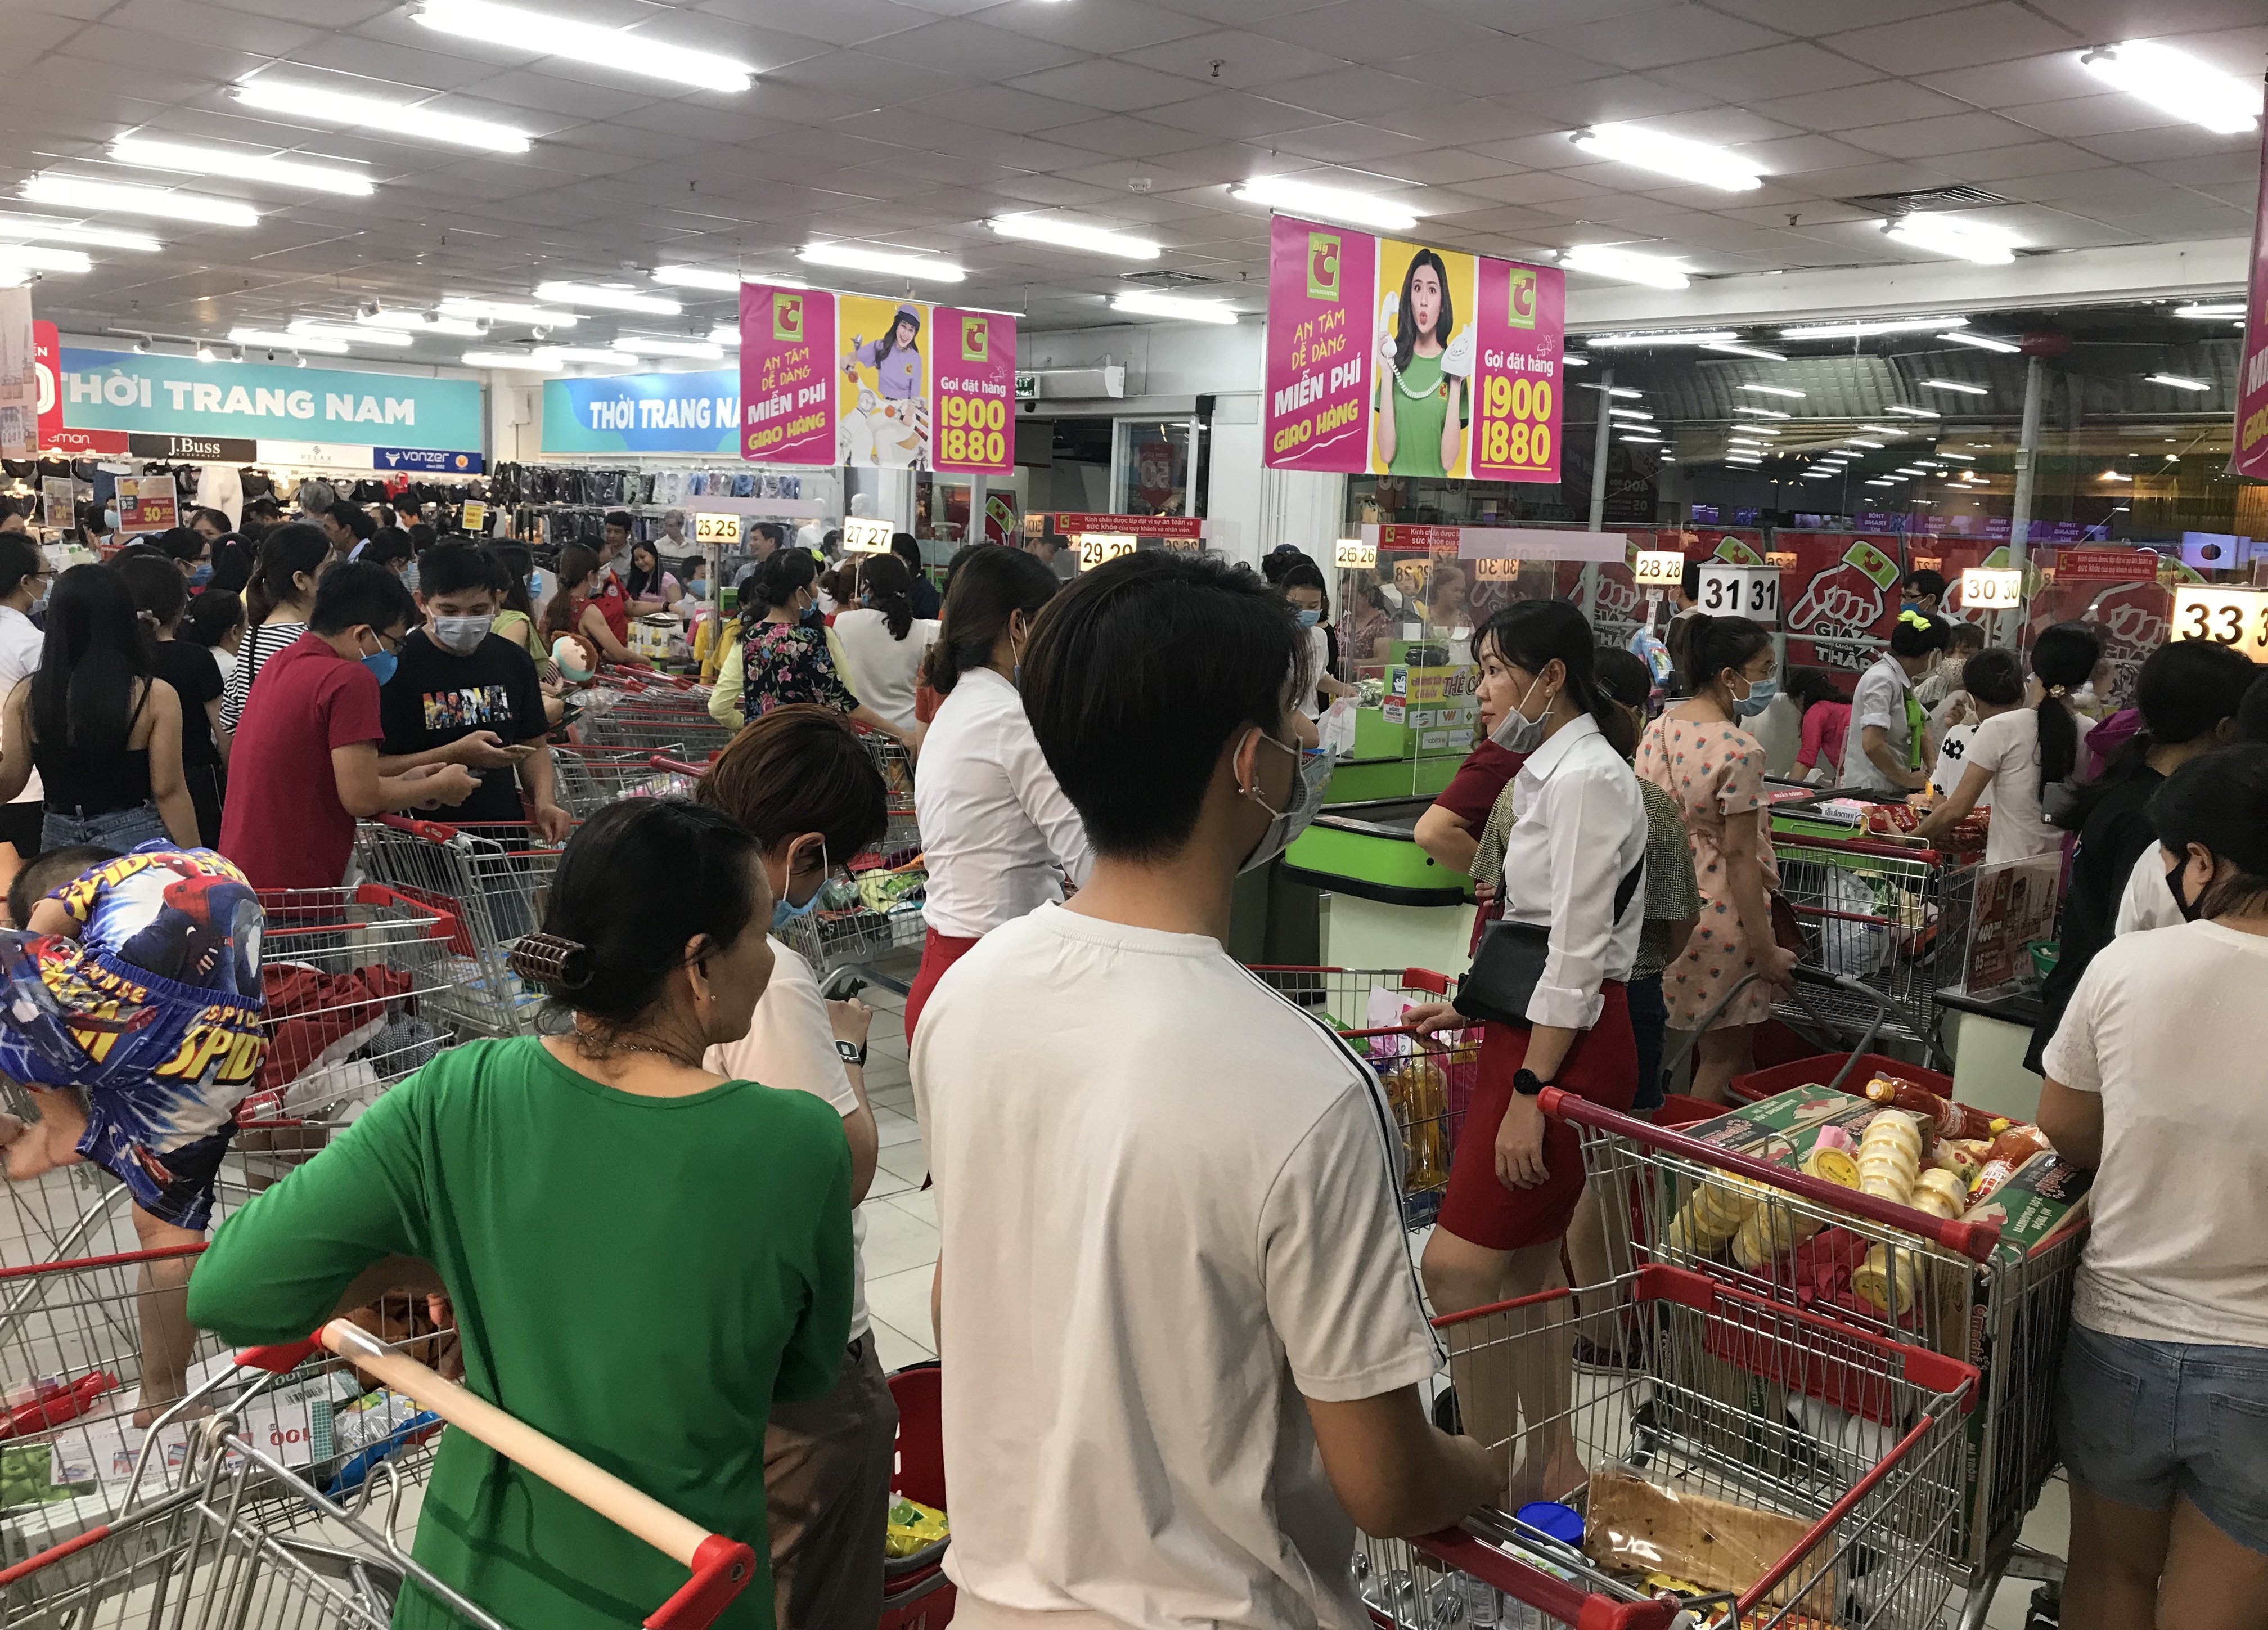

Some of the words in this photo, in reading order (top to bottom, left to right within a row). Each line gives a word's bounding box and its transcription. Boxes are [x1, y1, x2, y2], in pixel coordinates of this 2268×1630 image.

[1313, 240, 1328, 255] Big
[1513, 275, 1526, 288] Big
[778, 299, 791, 309] Big
[1294, 320, 1313, 344] AN
[1318, 308, 1344, 333] TÂM
[763, 356, 780, 372] AN
[785, 347, 809, 365] TÂM
[1292, 341, 1306, 371] DỄ
[1312, 334, 1346, 362] DÀNG
[1484, 349, 1503, 372] Gọi
[1506, 352, 1525, 374] đặt
[1528, 354, 1553, 377] hàng
[762, 370, 776, 391] DỄ
[780, 365, 811, 385] DÀNG
[940, 376, 958, 393] Gọi
[962, 379, 979, 394] đặt
[982, 381, 1006, 397] hàng
[1274, 368, 1324, 418] MIỄN
[1330, 352, 1361, 394] PHÍ
[164, 380, 315, 419] TRANG
[325, 393, 415, 425] NAM
[590, 393, 634, 429] THỜI
[639, 398, 711, 429] TRANG
[748, 389, 792, 425] MIỄN
[798, 378, 826, 408] PHÍ
[1483, 375, 1551, 422] 1900
[941, 396, 1005, 430] 1900
[1274, 419, 1312, 453] GIAO
[1316, 398, 1358, 436] HÀNG
[748, 426, 783, 450] GIAO
[787, 411, 825, 438] HÀNG
[1481, 420, 1550, 465] 1880
[169, 438, 220, 456] J.Buss
[941, 428, 1005, 462] 1880
[699, 520, 710, 536] 25
[716, 520, 736, 537] 25
[847, 525, 862, 543] 27
[867, 528, 889, 546] 27
[1412, 536, 1425, 544] sức
[1083, 542, 1103, 564] 29
[1338, 547, 1357, 563] 26
[1360, 547, 1374, 563] 26
[1639, 560, 1660, 577] 28
[1666, 560, 1681, 578] 28
[1705, 578, 1739, 609] 31
[1752, 580, 1776, 611] 31
[1969, 580, 1996, 599] 30
[2004, 580, 2018, 600] 30
[2182, 603, 2243, 645] 33
